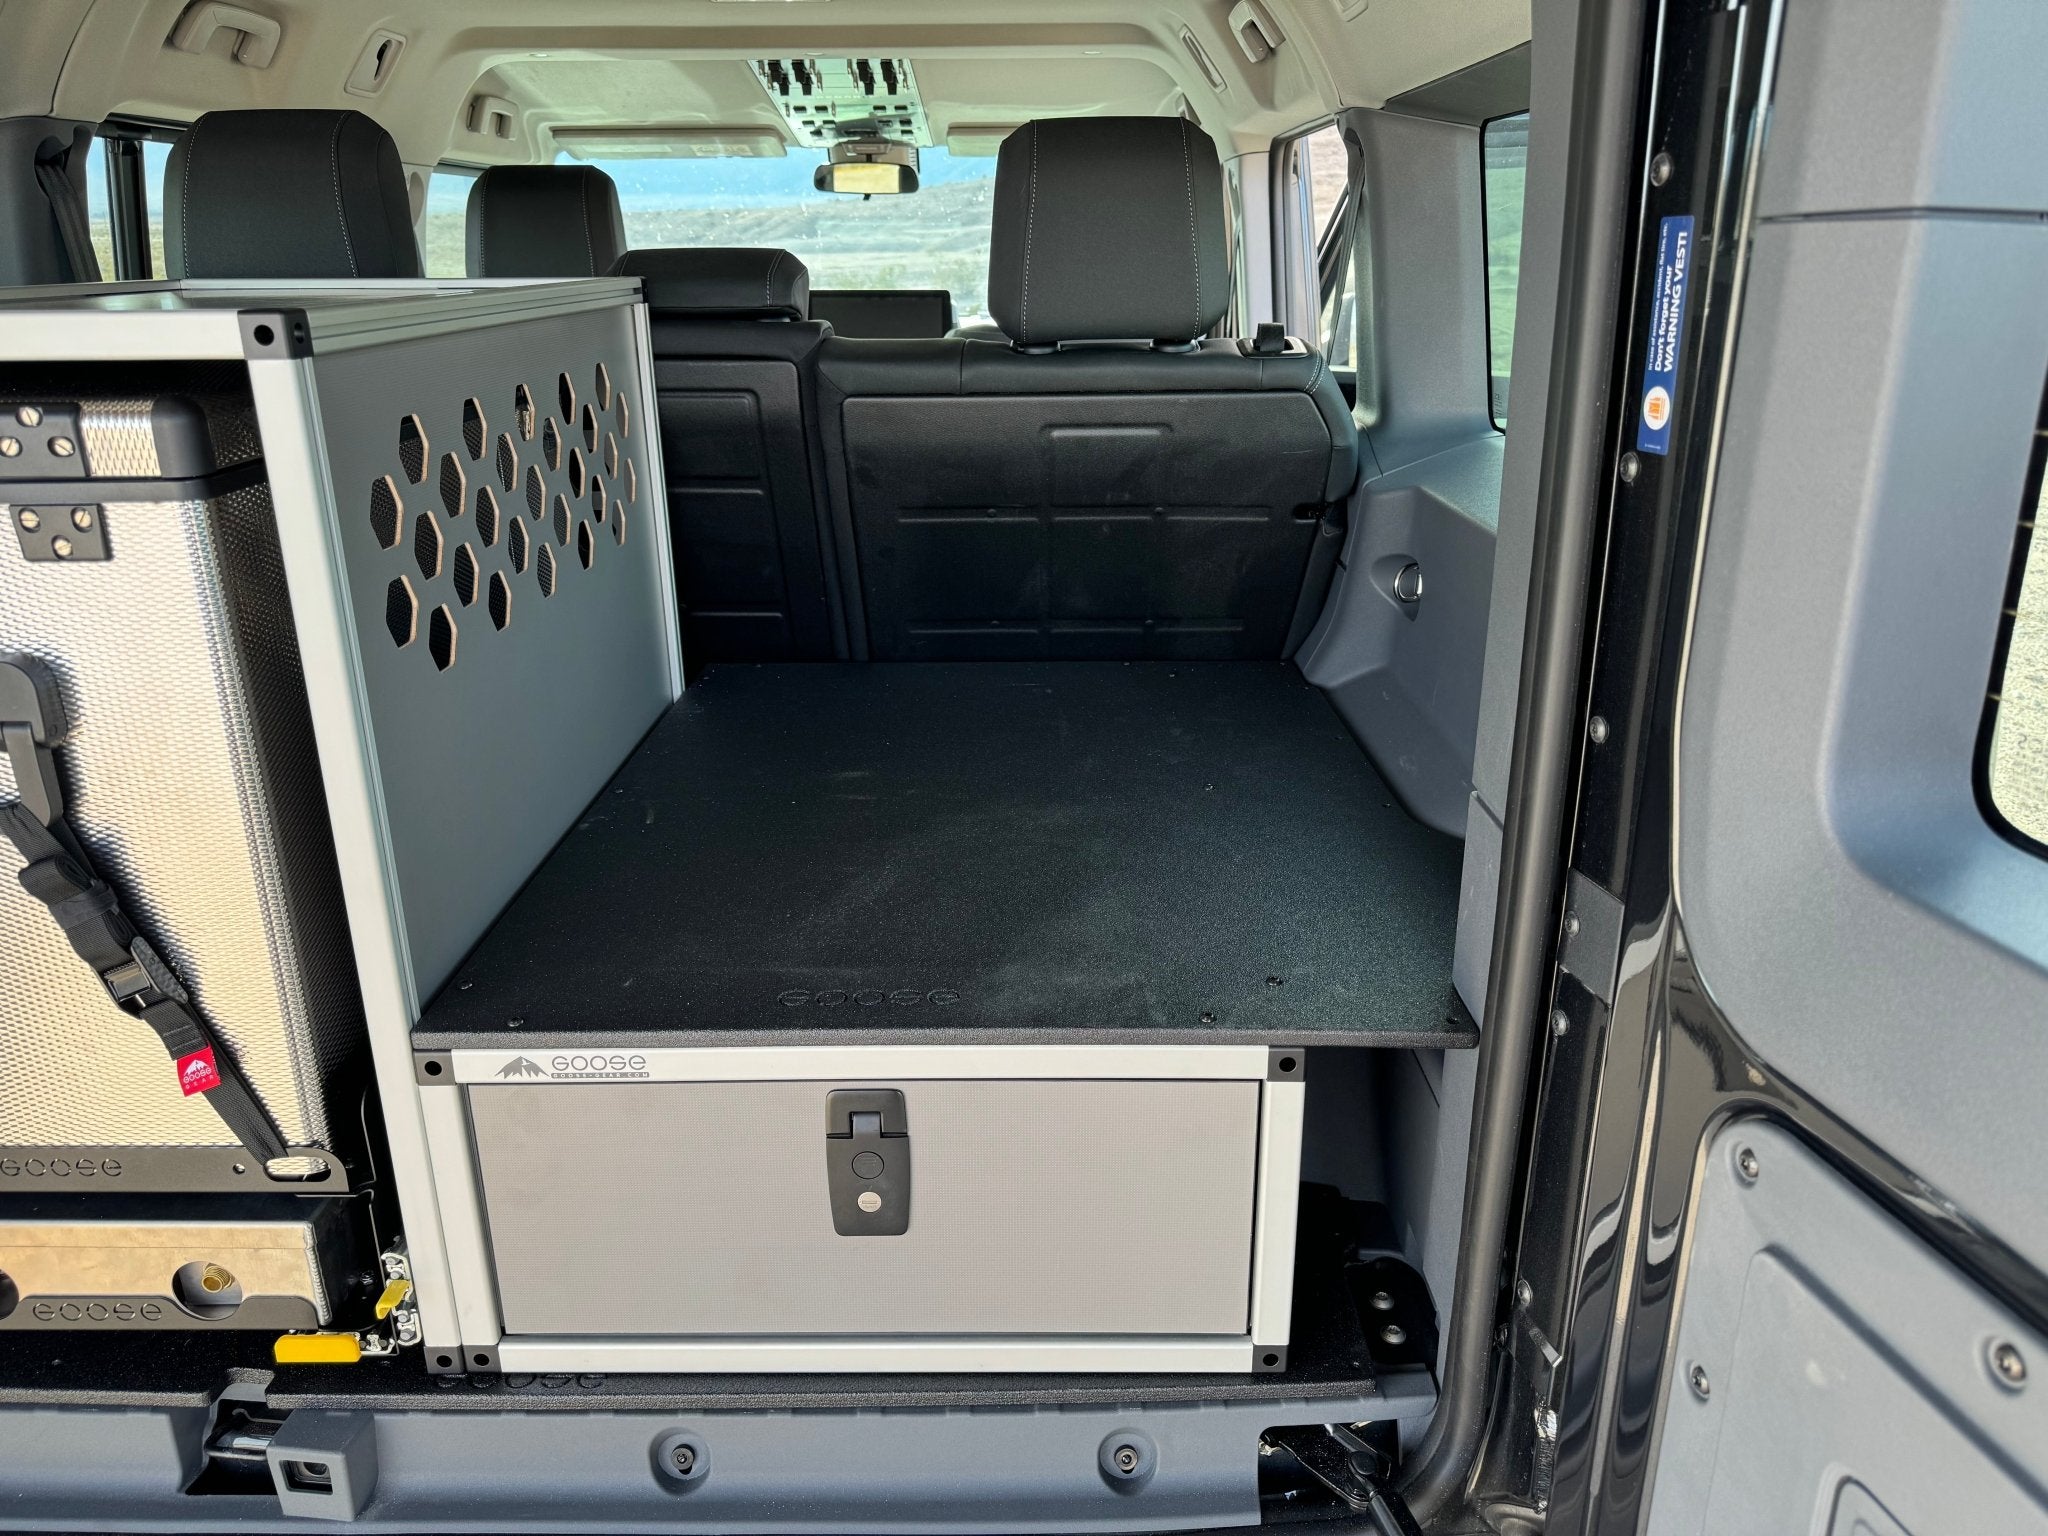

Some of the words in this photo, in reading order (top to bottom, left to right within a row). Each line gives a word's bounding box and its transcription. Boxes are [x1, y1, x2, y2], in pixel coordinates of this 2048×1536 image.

[1664, 264, 1673, 296] your
[1658, 296, 1670, 336] forget
[1663, 284, 1682, 373] WARNING
[1654, 337, 1665, 371] Don't
